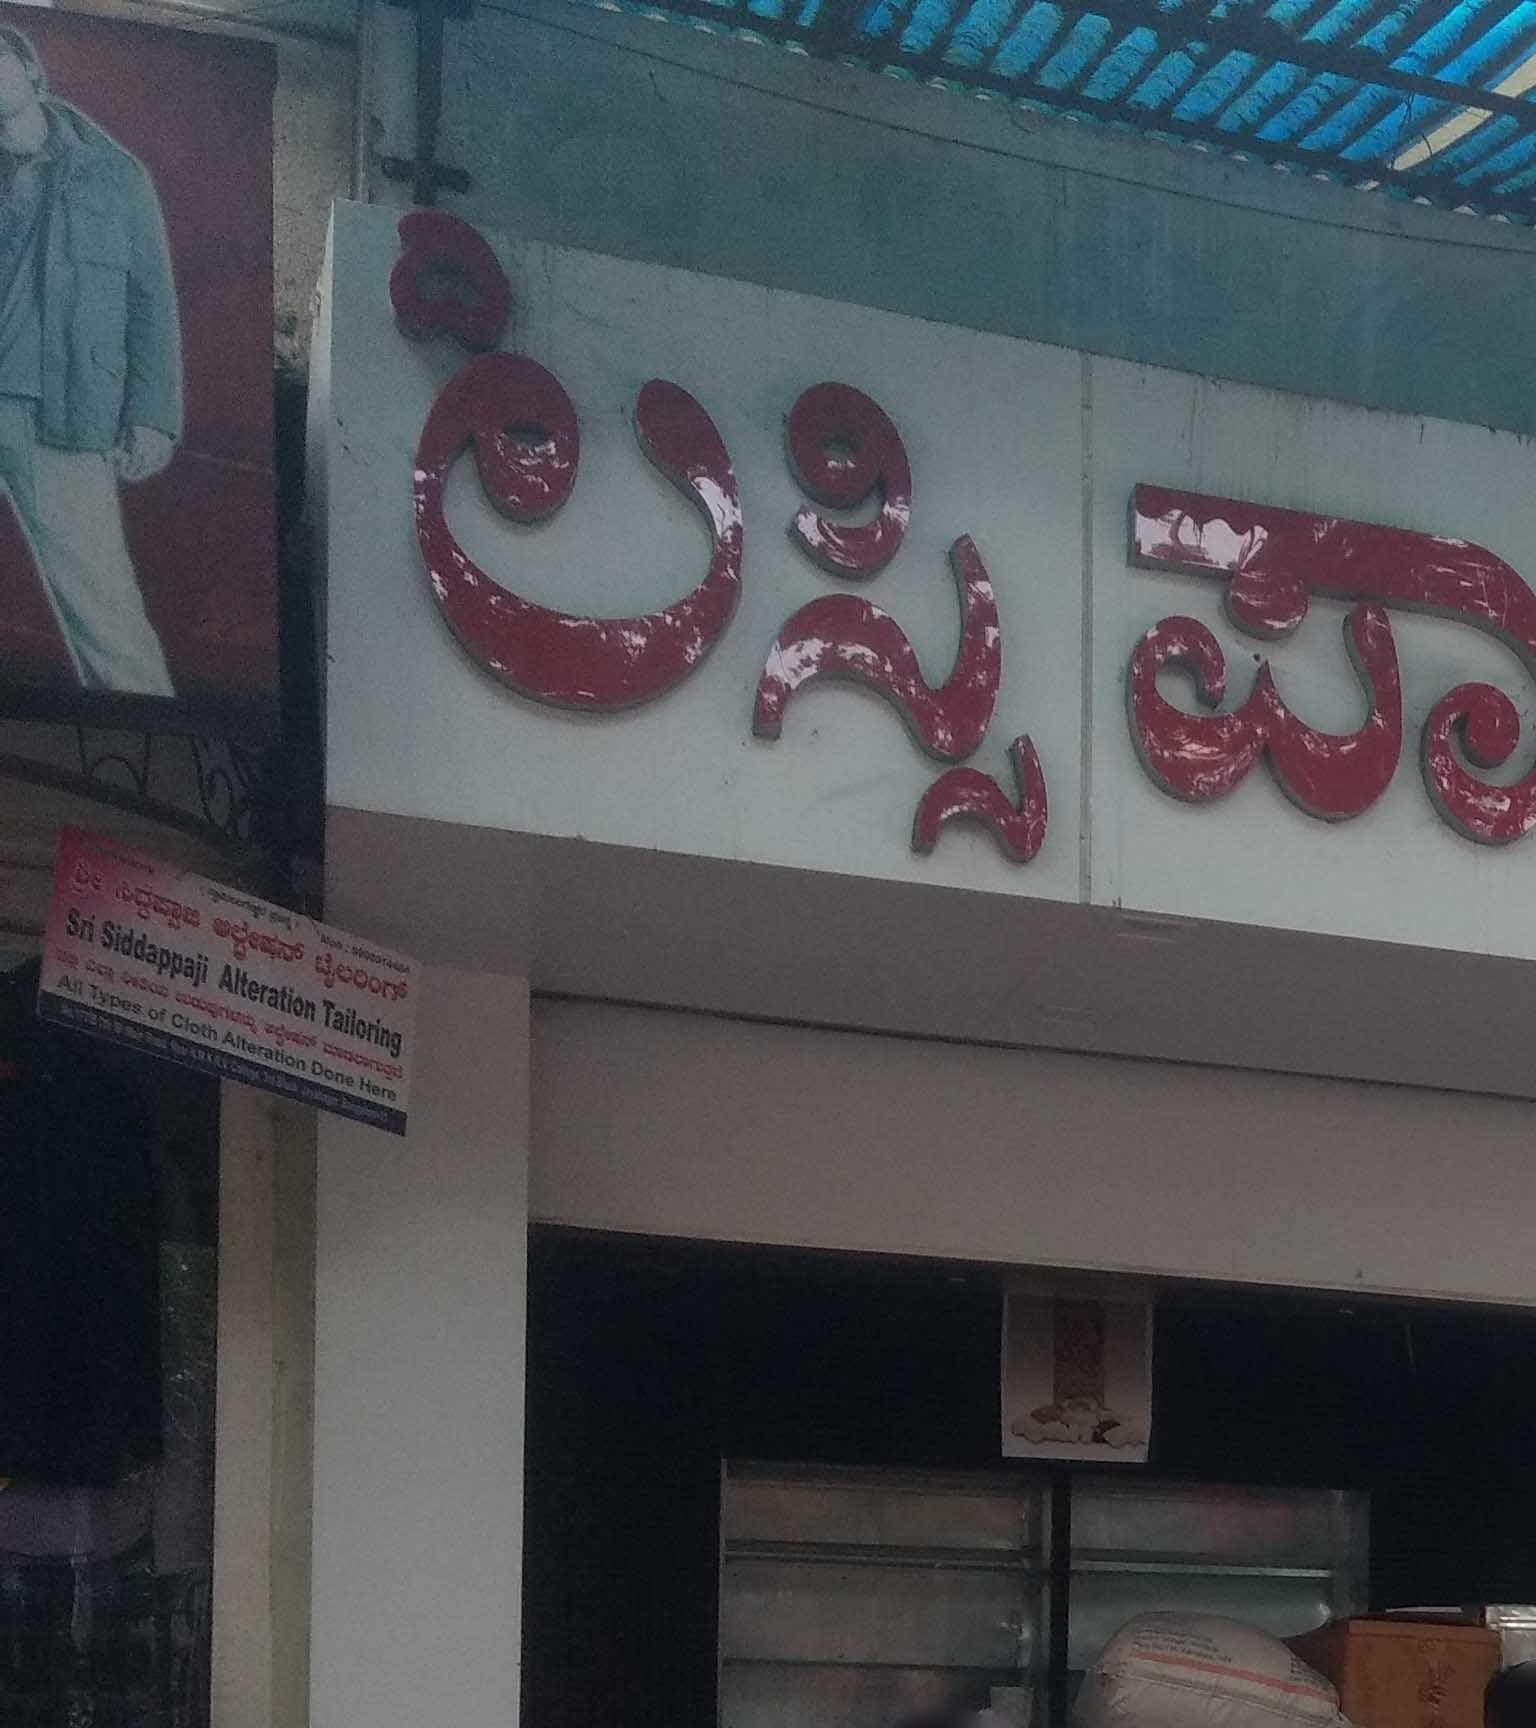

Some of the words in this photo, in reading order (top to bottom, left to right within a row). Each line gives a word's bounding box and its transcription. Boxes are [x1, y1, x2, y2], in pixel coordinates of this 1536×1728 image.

[66, 904, 94, 944] Sri
[101, 919, 209, 986] Siddappaji
[219, 968, 316, 1023] Alteration
[323, 999, 402, 1059] Tailoring
[91, 984, 143, 1018] Types
[147, 1001, 166, 1025] of
[171, 1010, 218, 1041] Cloth
[222, 1028, 307, 1072] Alteration
[311, 1061, 355, 1090] Done
